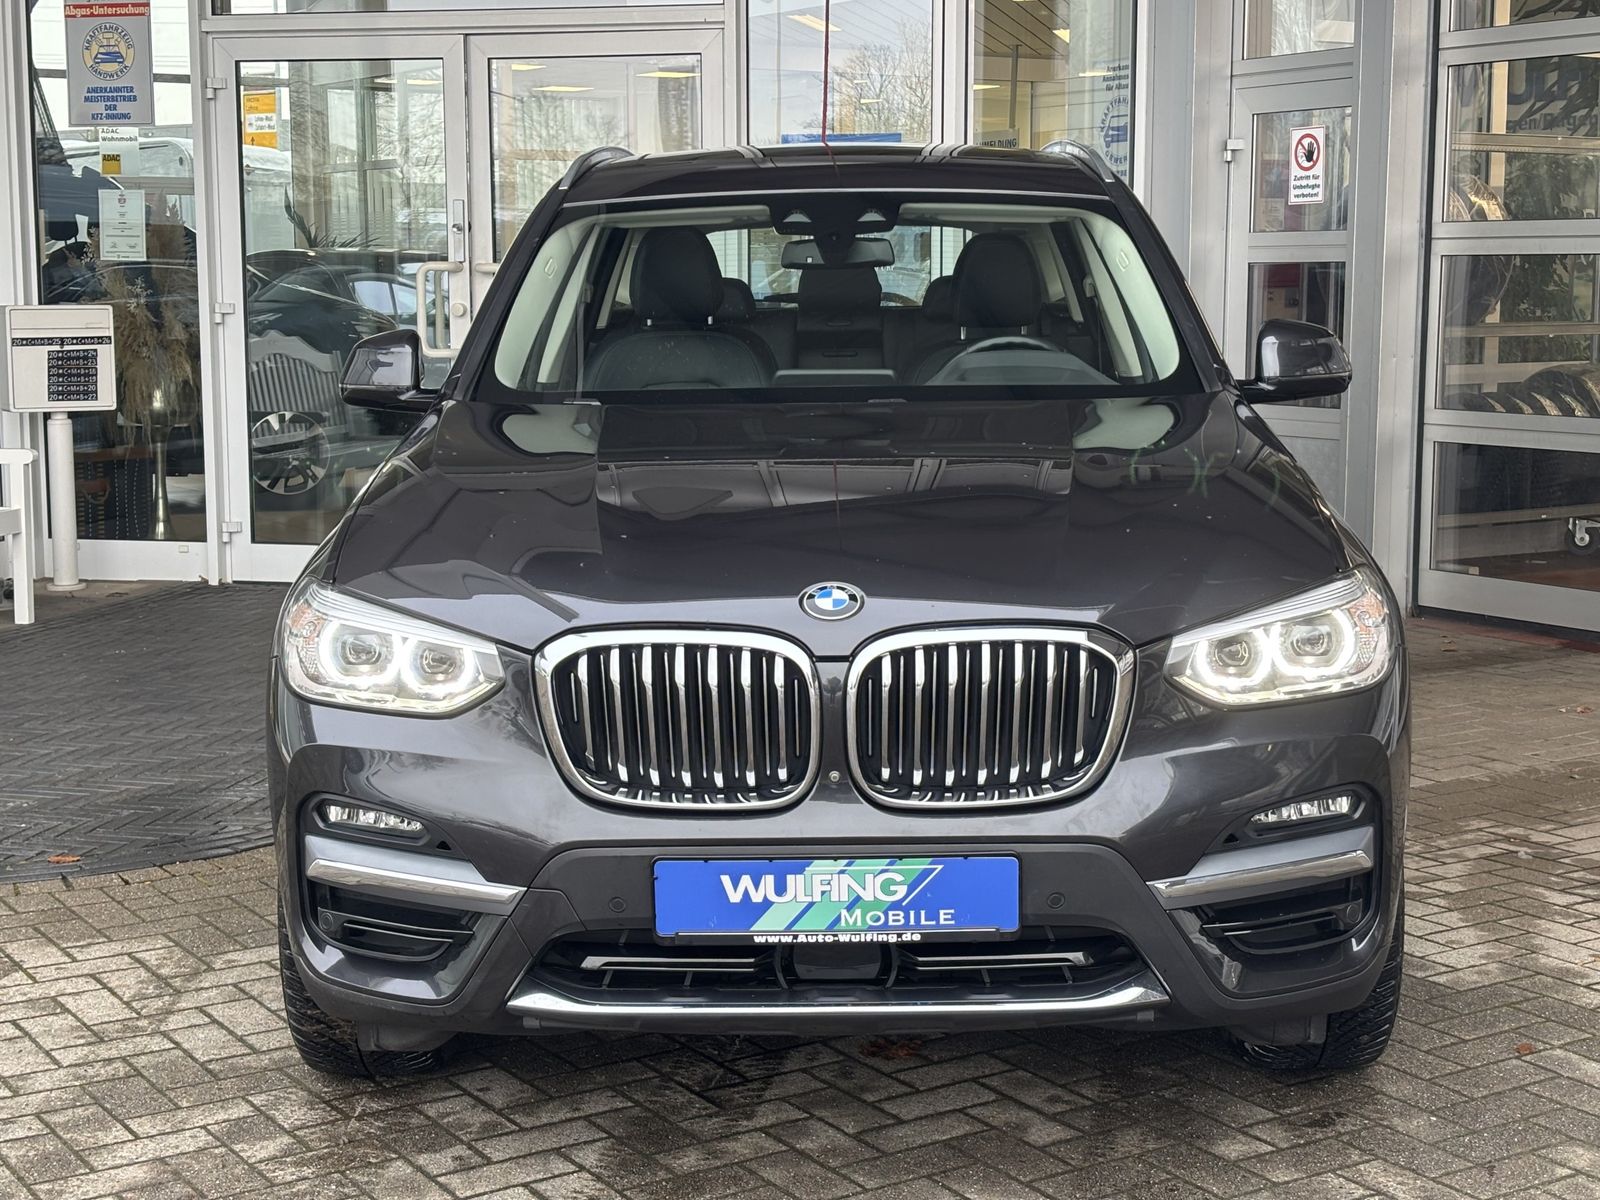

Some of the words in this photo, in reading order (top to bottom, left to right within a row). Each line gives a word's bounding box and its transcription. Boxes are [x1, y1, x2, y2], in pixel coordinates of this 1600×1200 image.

[65, 4, 149, 17] Abgas-Untersuchung
[84, 24, 133, 51] KRAFTFAHRZEUG
[89, 64, 129, 79] HANDWERK
[86, 86, 134, 94] ANERKANNTER
[84, 94, 138, 103] MEISTERBETRIEB
[104, 103, 118, 112] DER
[91, 112, 132, 121] KFZ-INNUNG
[102, 153, 121, 162] ADAC
[720, 872, 908, 904] WULFING
[753, 933, 922, 943] www.Auto-Wulfing.de
